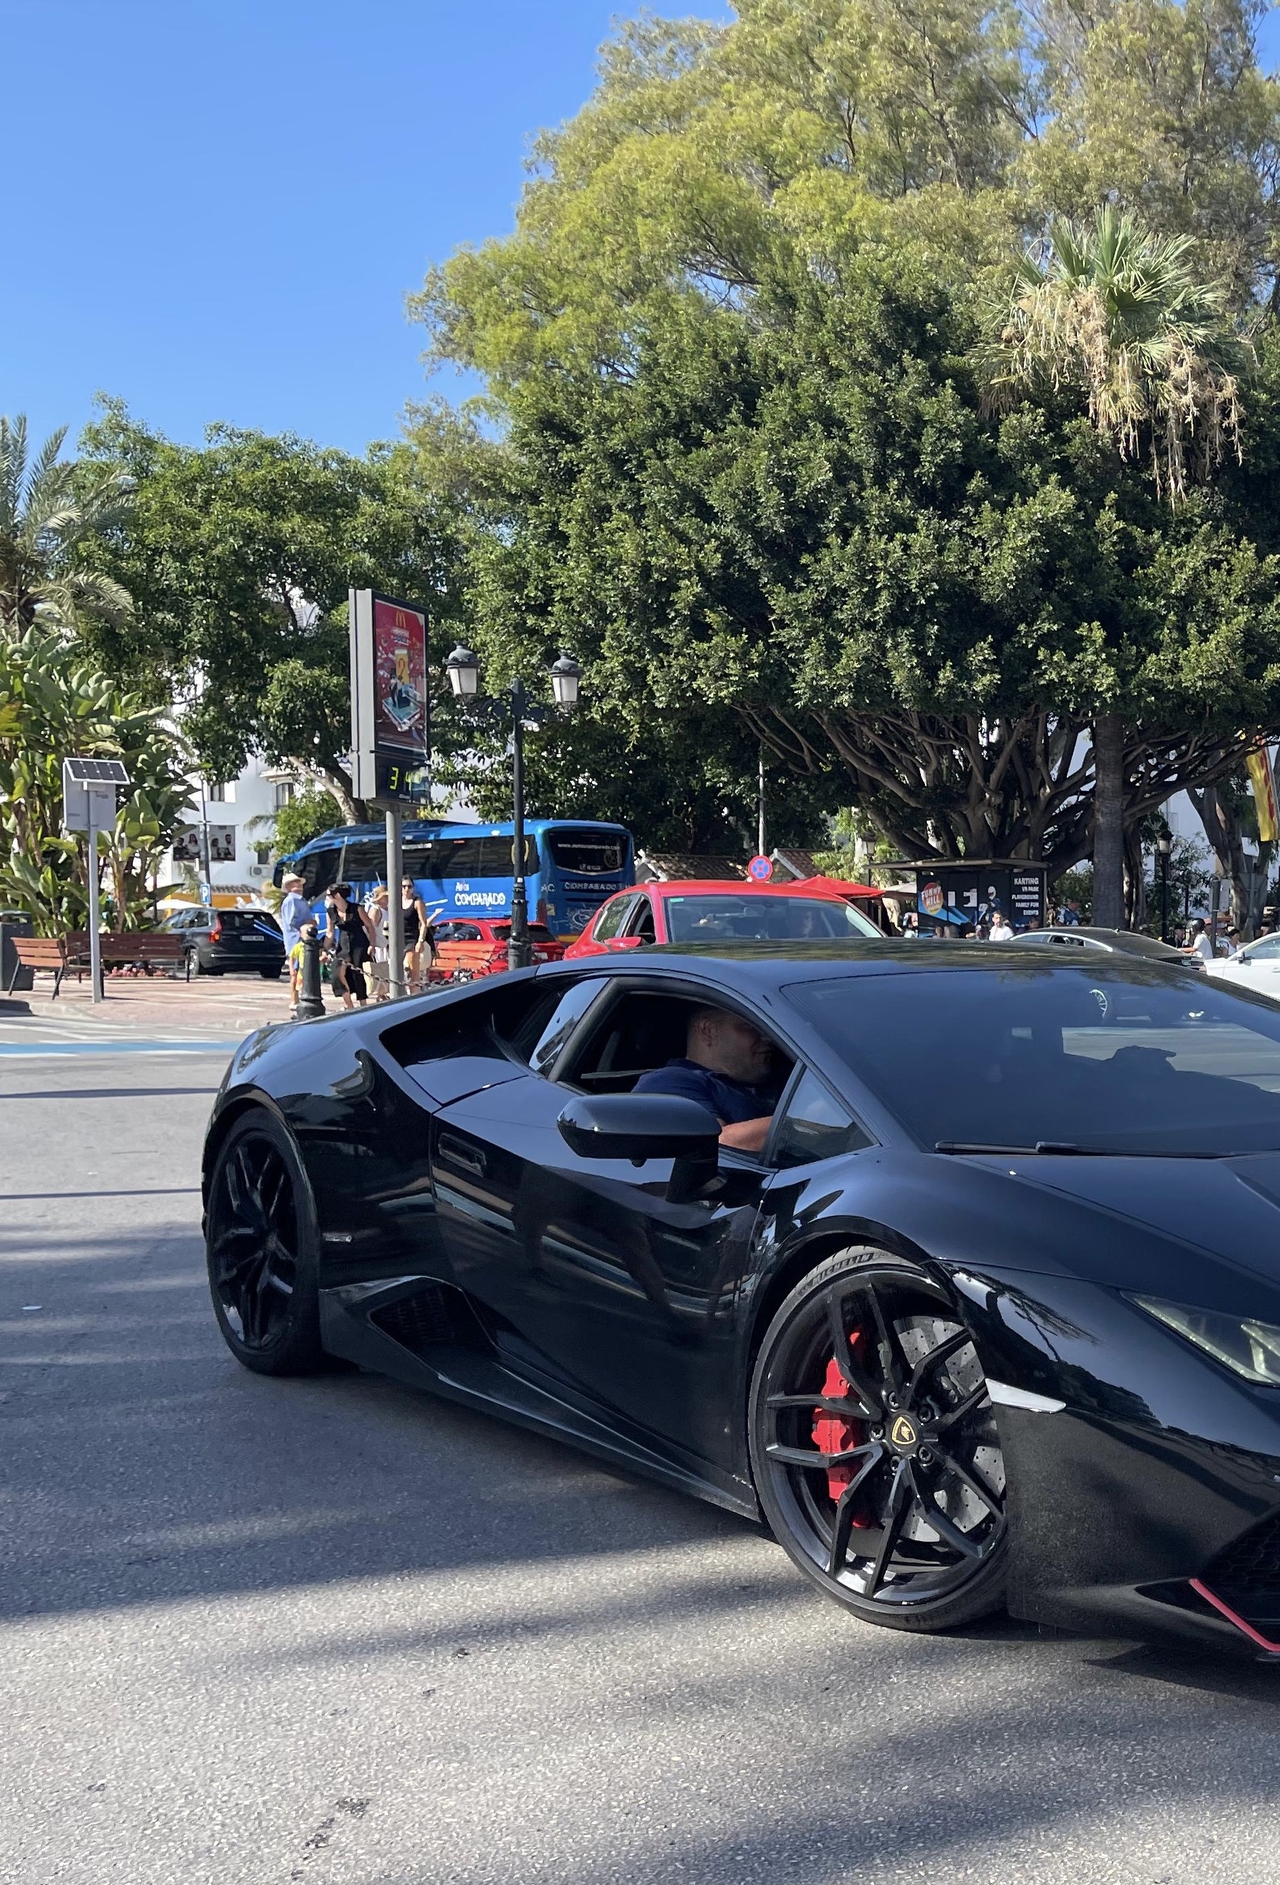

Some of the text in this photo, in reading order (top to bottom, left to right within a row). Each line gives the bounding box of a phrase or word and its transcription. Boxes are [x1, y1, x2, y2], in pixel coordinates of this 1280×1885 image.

[1014, 877, 1040, 885] KARTING
[454, 892, 506, 906] COMPARADO
[811, 1252, 873, 1286] MICHELIN
